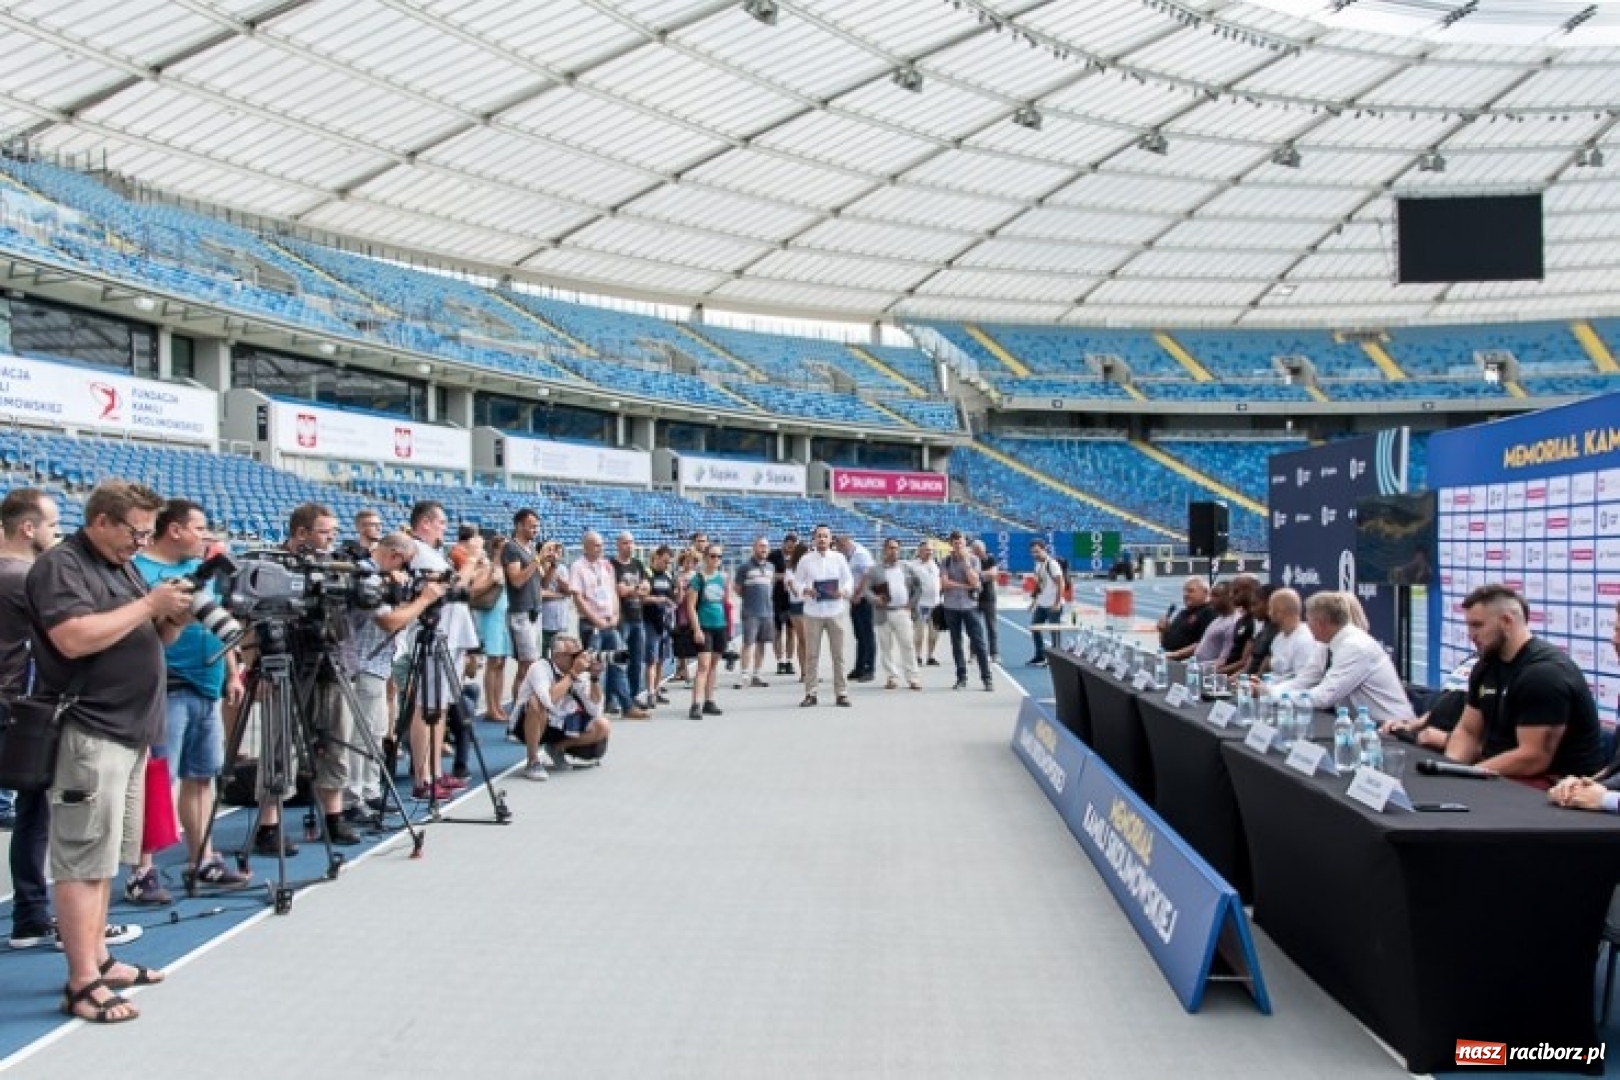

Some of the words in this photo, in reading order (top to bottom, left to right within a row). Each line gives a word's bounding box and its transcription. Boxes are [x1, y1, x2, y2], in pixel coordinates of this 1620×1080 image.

[132, 386, 178, 404] FUNDACJA
[851, 475, 887, 489] TAURON
[909, 479, 943, 492] TAURON
